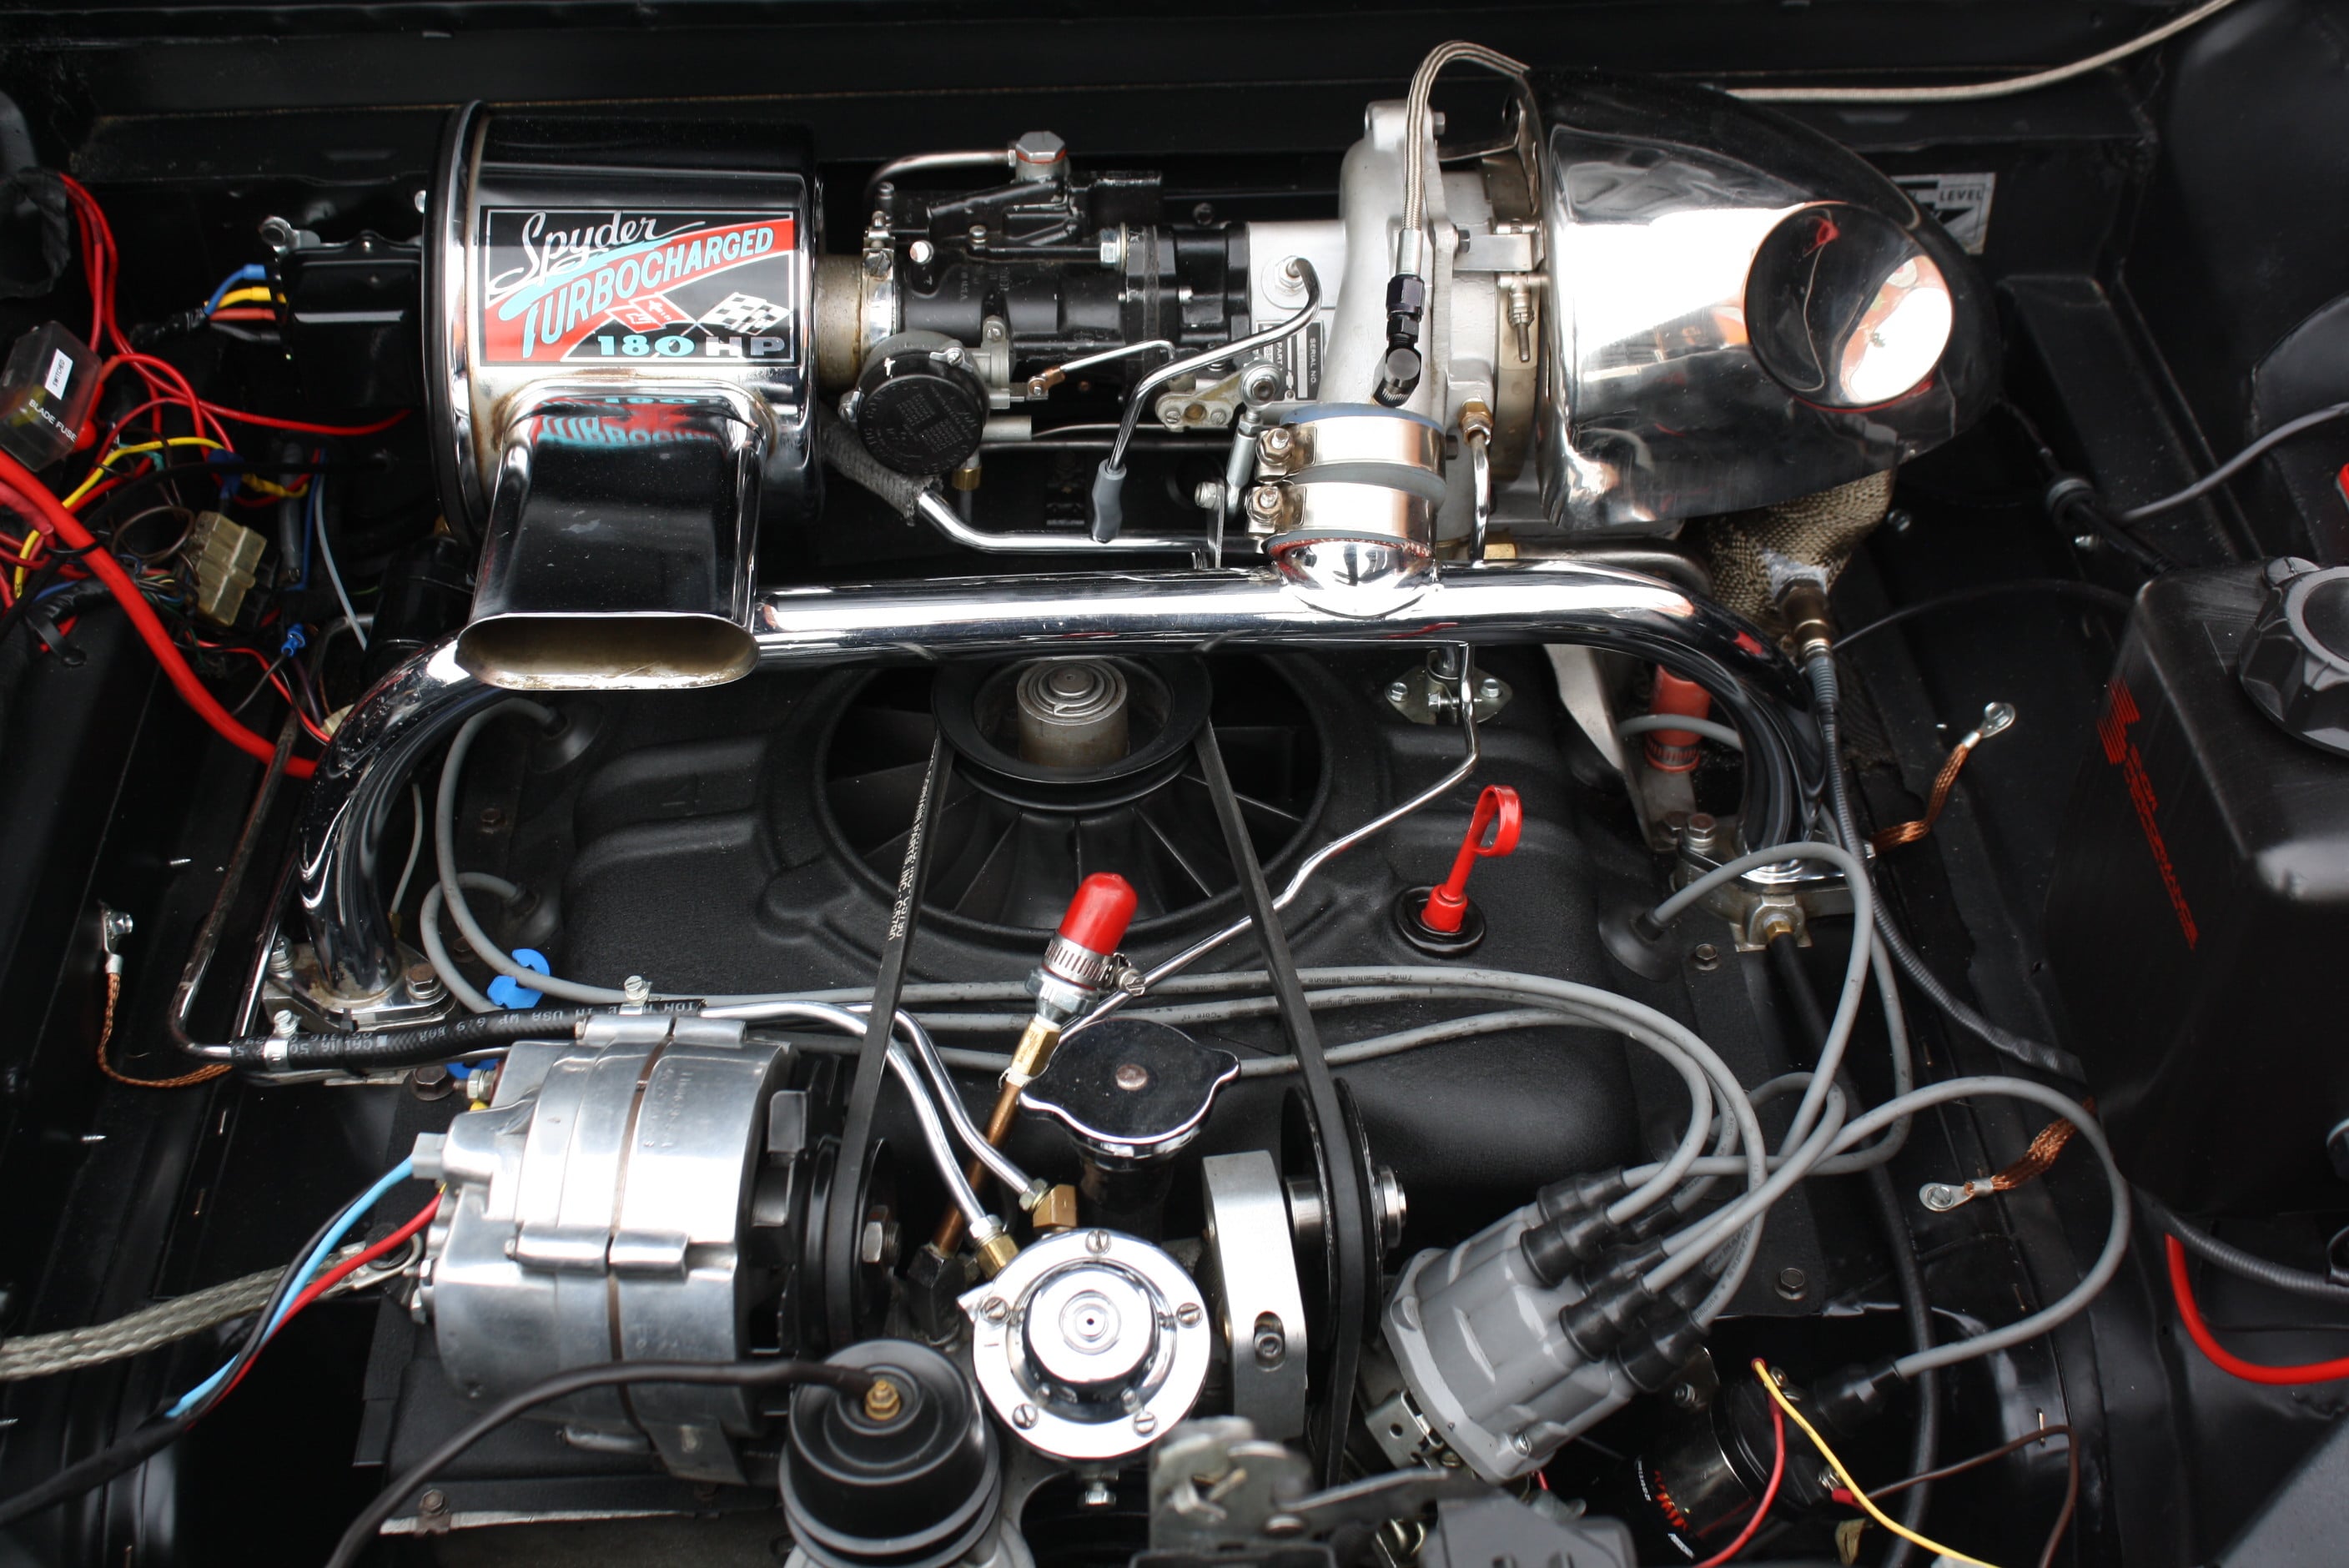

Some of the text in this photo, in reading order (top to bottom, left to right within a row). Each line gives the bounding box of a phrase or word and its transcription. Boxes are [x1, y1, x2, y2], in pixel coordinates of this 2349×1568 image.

[1939, 188, 1983, 202] LEVEL
[492, 211, 706, 287] Spyder
[498, 227, 774, 359] TURBOCHARGED
[597, 334, 787, 356] 180 HP
[28, 399, 78, 443] BLADE FUSE
[498, 1014, 520, 1026] WP
[532, 1010, 563, 1022] USA
[420, 1024, 446, 1043] BAR
